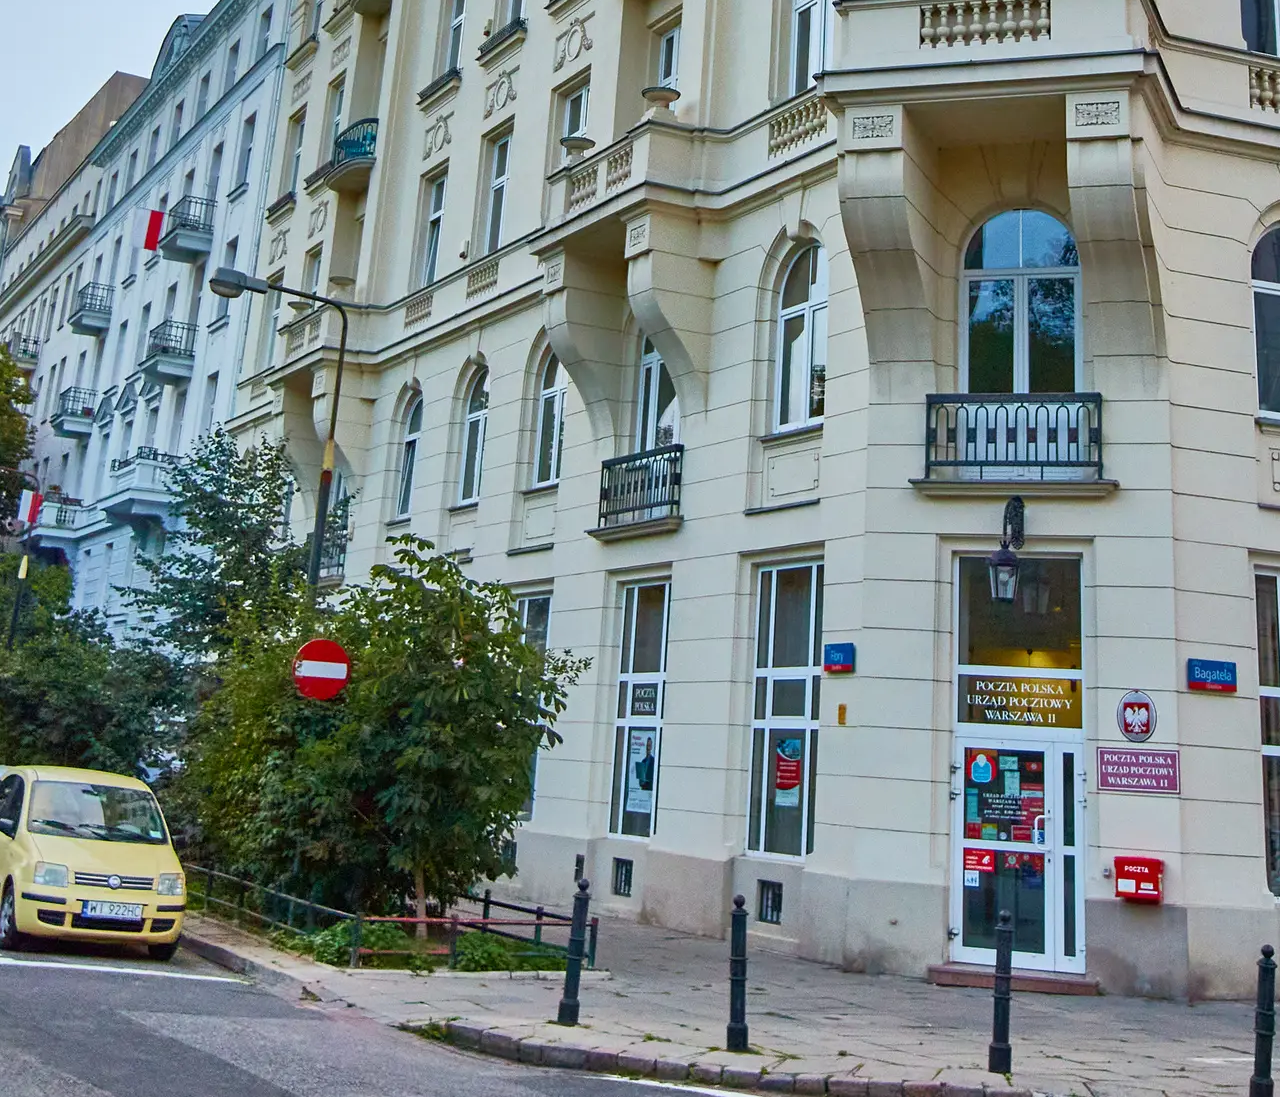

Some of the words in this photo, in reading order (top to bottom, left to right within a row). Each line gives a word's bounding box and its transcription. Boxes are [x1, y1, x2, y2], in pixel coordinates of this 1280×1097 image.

[1194, 666, 1232, 682] Bagatela
[635, 688, 655, 698] POCZTA
[975, 681, 1018, 692] POCZTA
[1021, 683, 1064, 695] POLSKA
[635, 701, 655, 712] POLSKA
[967, 694, 1006, 709] URZĄD
[1009, 697, 1073, 709] POCZTOWY
[985, 709, 1044, 723] WARSZAWA
[1104, 753, 1137, 763] POCZTA
[1139, 755, 1172, 764] POLSKA
[1131, 766, 1175, 776] POCZTOWY
[1108, 776, 1157, 787] WARSZAWA
[1124, 865, 1149, 873] POCZTA
[109, 904, 141, 917] 922HC
